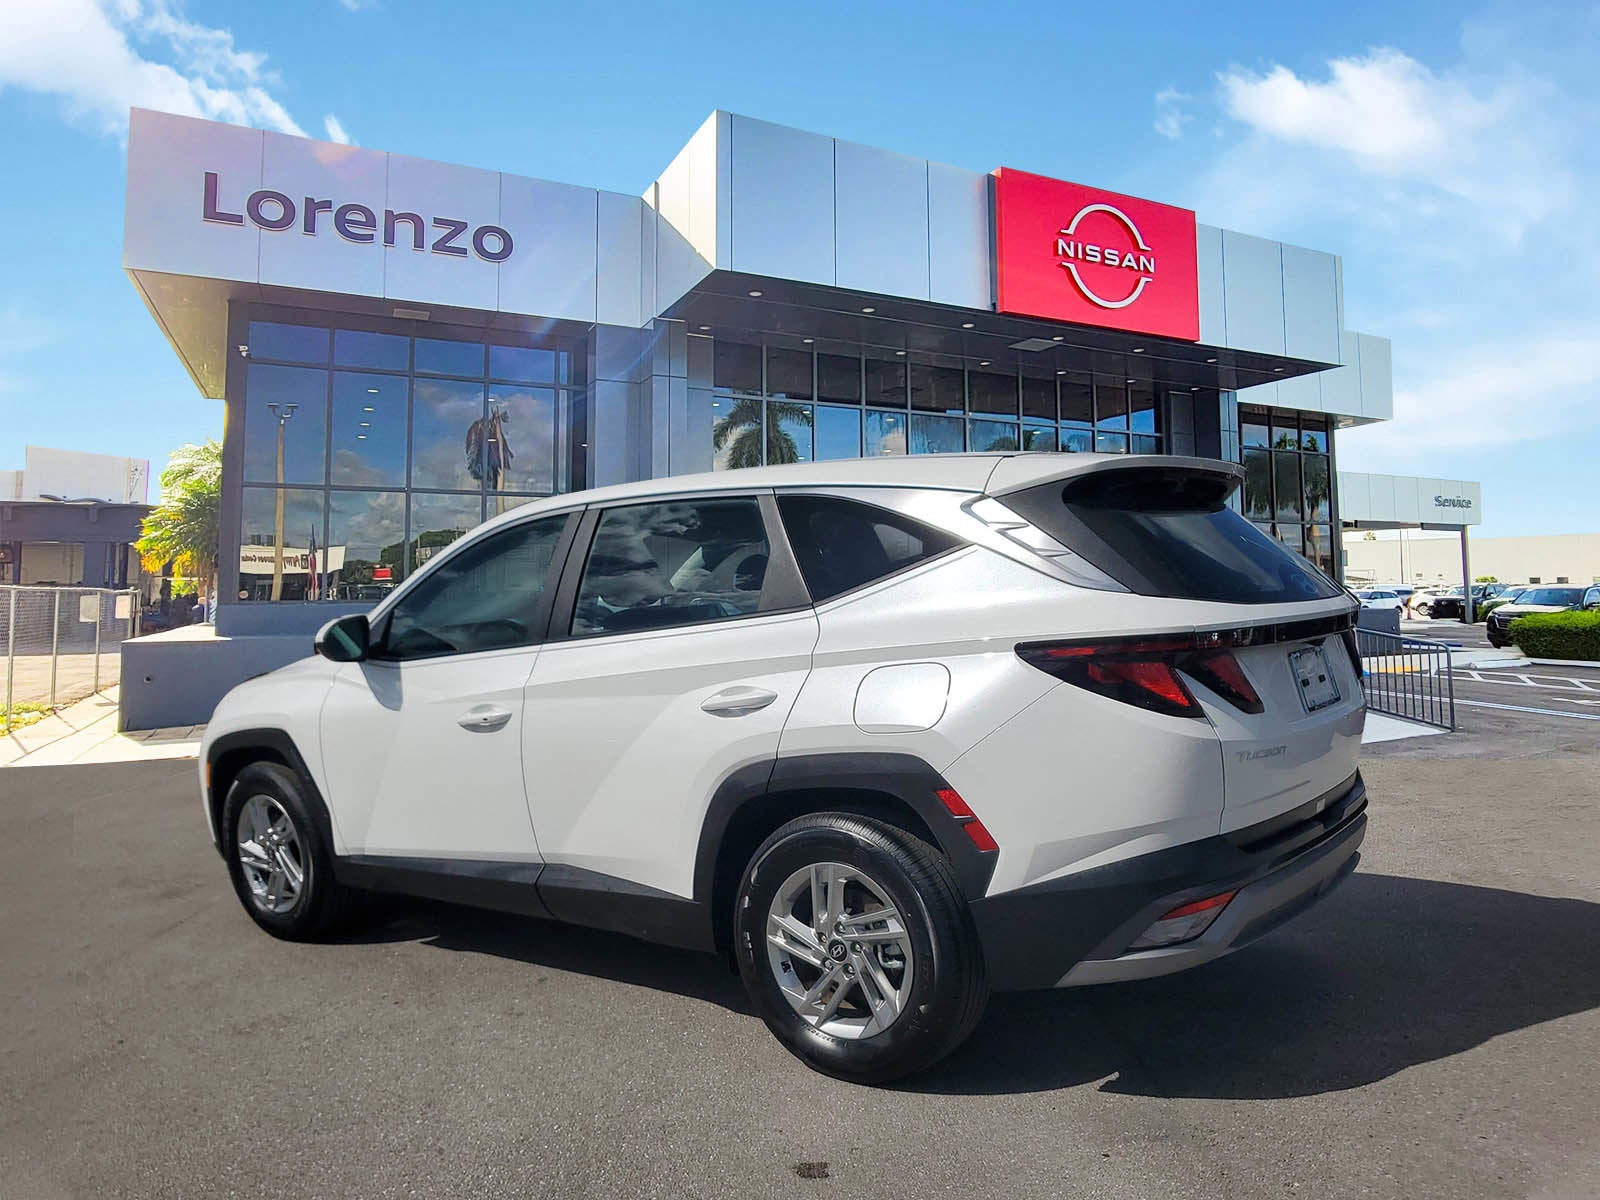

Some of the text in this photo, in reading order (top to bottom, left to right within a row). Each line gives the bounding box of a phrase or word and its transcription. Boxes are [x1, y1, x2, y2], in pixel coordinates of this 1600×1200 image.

[202, 171, 514, 263] Lorenzo
[1057, 238, 1155, 273] NISSAN
[1434, 495, 1472, 508] Service
